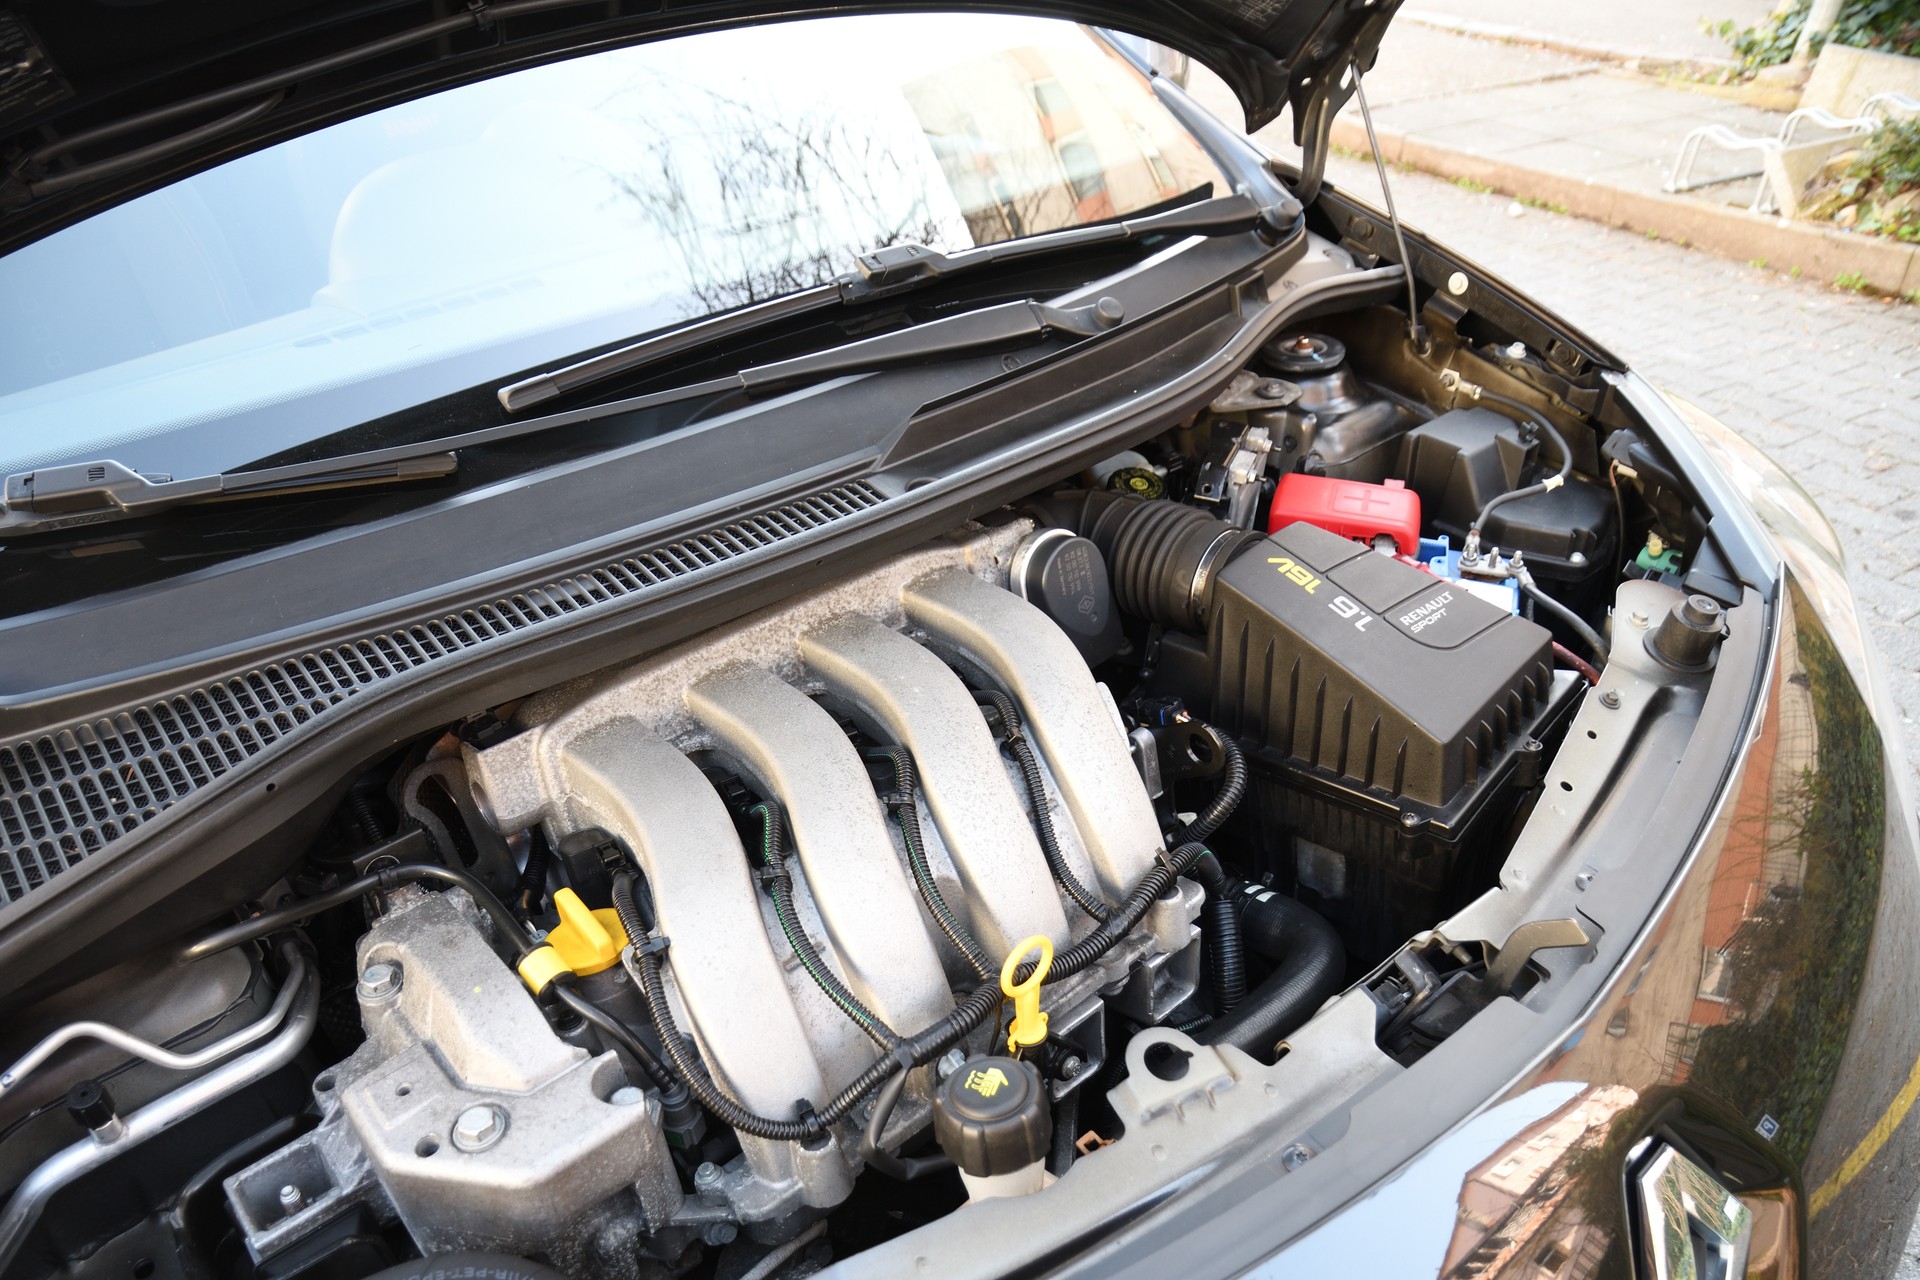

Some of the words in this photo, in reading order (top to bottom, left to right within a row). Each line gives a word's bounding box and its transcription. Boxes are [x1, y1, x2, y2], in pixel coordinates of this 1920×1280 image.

[1267, 558, 1322, 595] 16V
[1328, 596, 1373, 632] 1.6
[1399, 591, 1454, 626] RENAULT
[1411, 608, 1447, 634] SPORT
